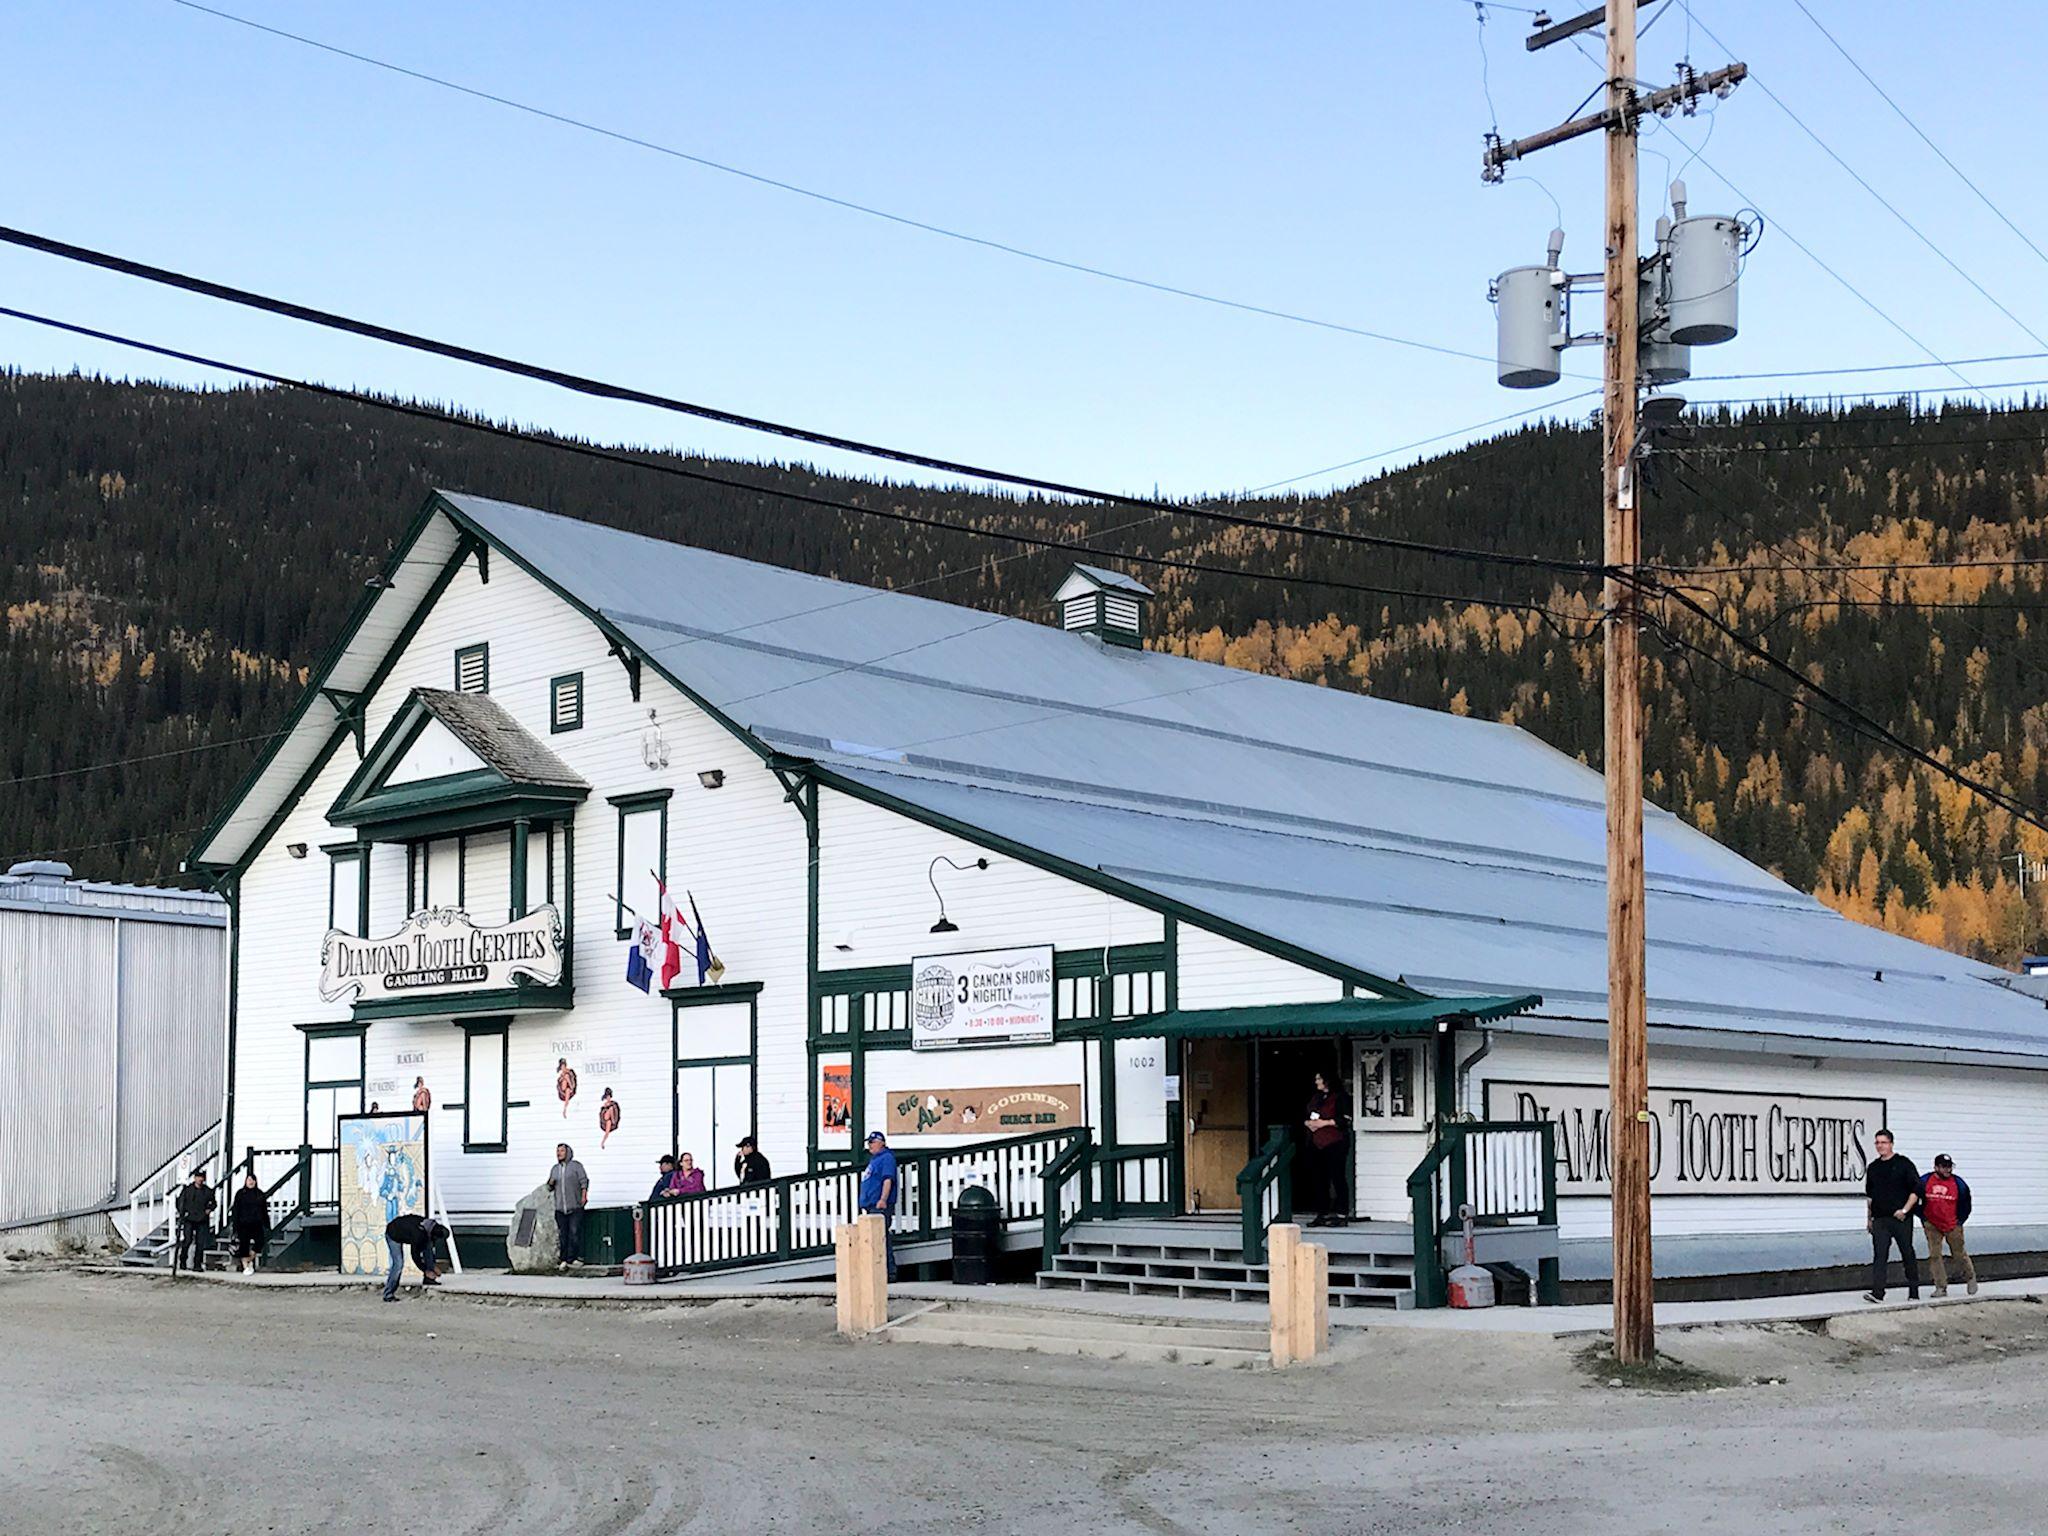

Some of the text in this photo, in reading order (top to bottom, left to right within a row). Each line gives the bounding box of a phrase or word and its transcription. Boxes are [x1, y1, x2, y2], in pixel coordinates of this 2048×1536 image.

[338, 929, 545, 978] DIAMOND TOOTH GERTIES
[385, 966, 486, 988] GAMBLING HALL
[973, 972, 1012, 988] CANCAN
[1015, 968, 1051, 985] SHOWS
[957, 975, 969, 1004] 3
[973, 987, 1013, 1003] NIGHTLY
[552, 1040, 583, 1053] POKER
[1129, 1057, 1155, 1068] 1002
[897, 1094, 919, 1117] BIG
[987, 1091, 1070, 1115] GOURMET
[917, 1098, 954, 1132] AL'S
[1668, 1098, 1759, 1182] TOOTH
[1766, 1103, 1868, 1183] GERTIES
